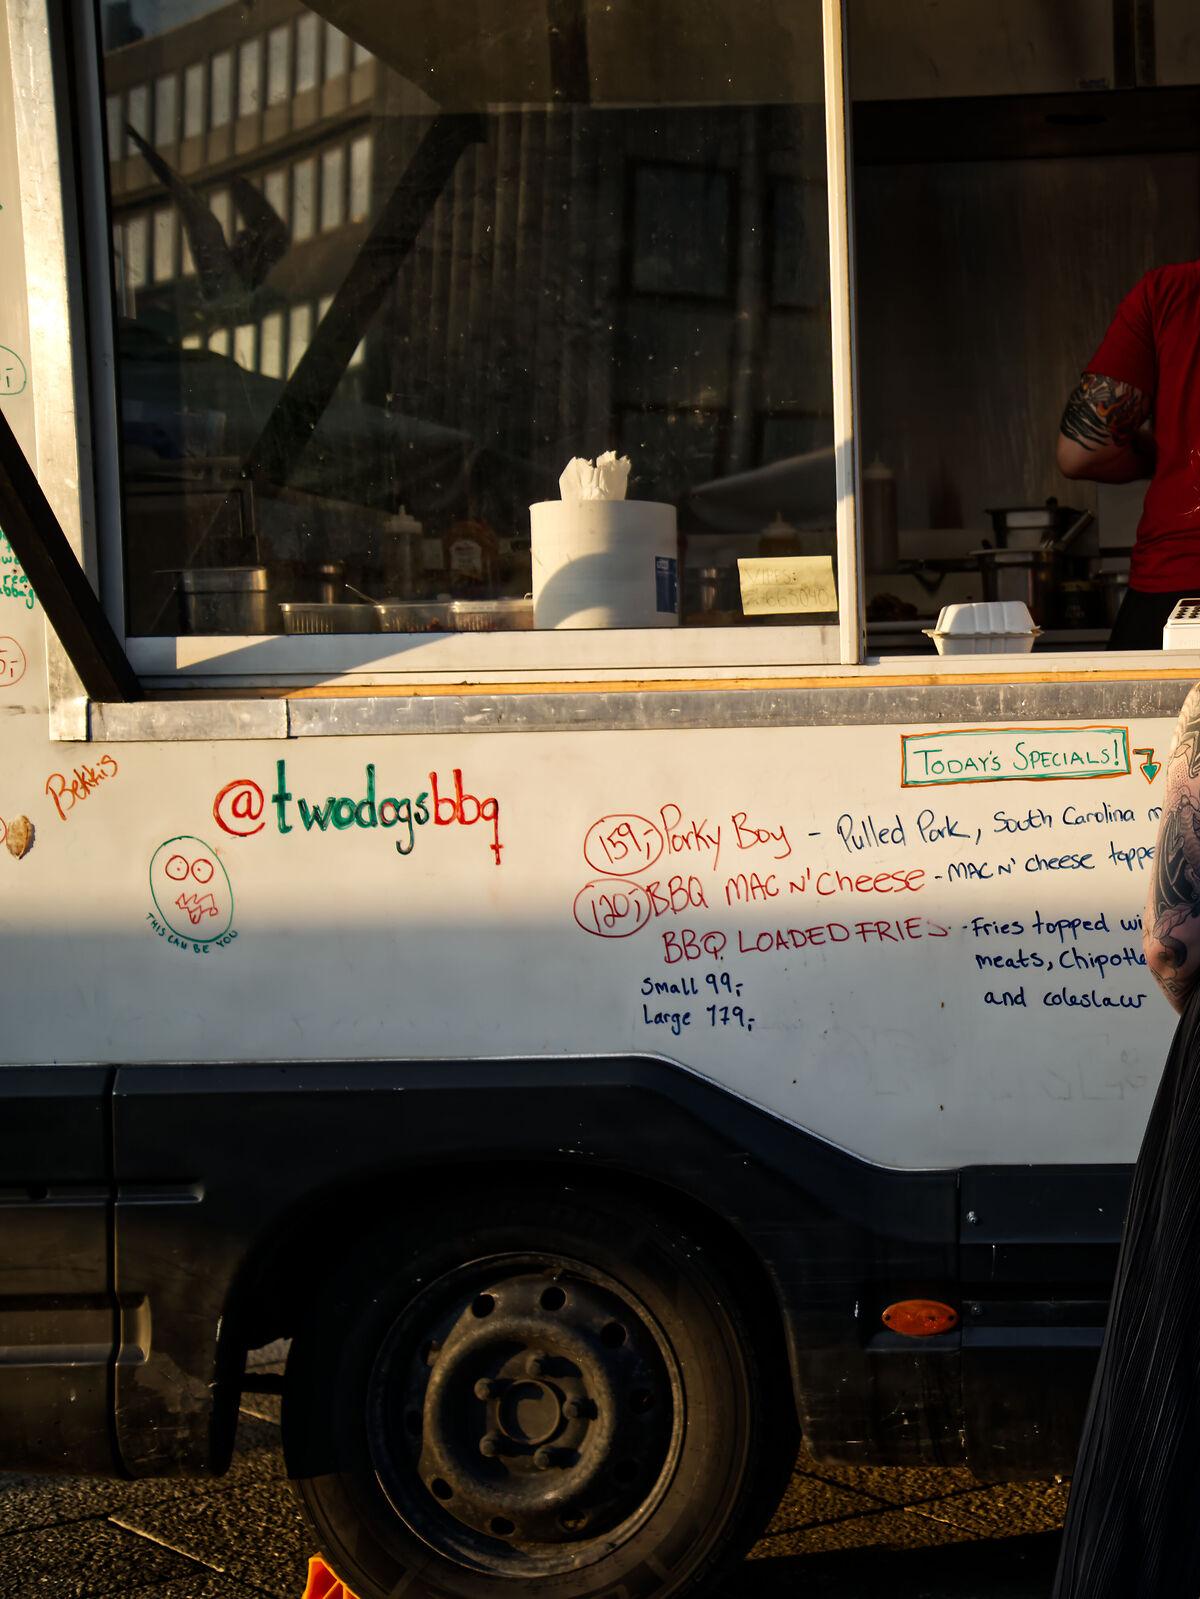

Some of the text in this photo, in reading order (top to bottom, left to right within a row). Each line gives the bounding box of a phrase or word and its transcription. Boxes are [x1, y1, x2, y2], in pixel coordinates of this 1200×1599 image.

[213, 759, 504, 865] @twodogsbbq
[660, 803, 720, 871] Porky
[732, 812, 792, 859] Boy
[837, 811, 906, 853] Pulled
[993, 810, 1052, 833] South
[1062, 802, 1135, 826] Carolina
[647, 875, 708, 917] BBQ
[726, 873, 779, 906] MAC
[1108, 841, 1155, 871] toppe
[146, 912, 238, 954] THIS CAN BE YOU
[662, 929, 727, 963] BBQ
[739, 921, 851, 953] LOADED
[1032, 910, 1110, 944] topped
[1120, 914, 1143, 931] wi
[975, 948, 1053, 971] meats,
[641, 977, 698, 995] Small
[984, 986, 1147, 1008] and coleslaw
[643, 1003, 691, 1036] Large
